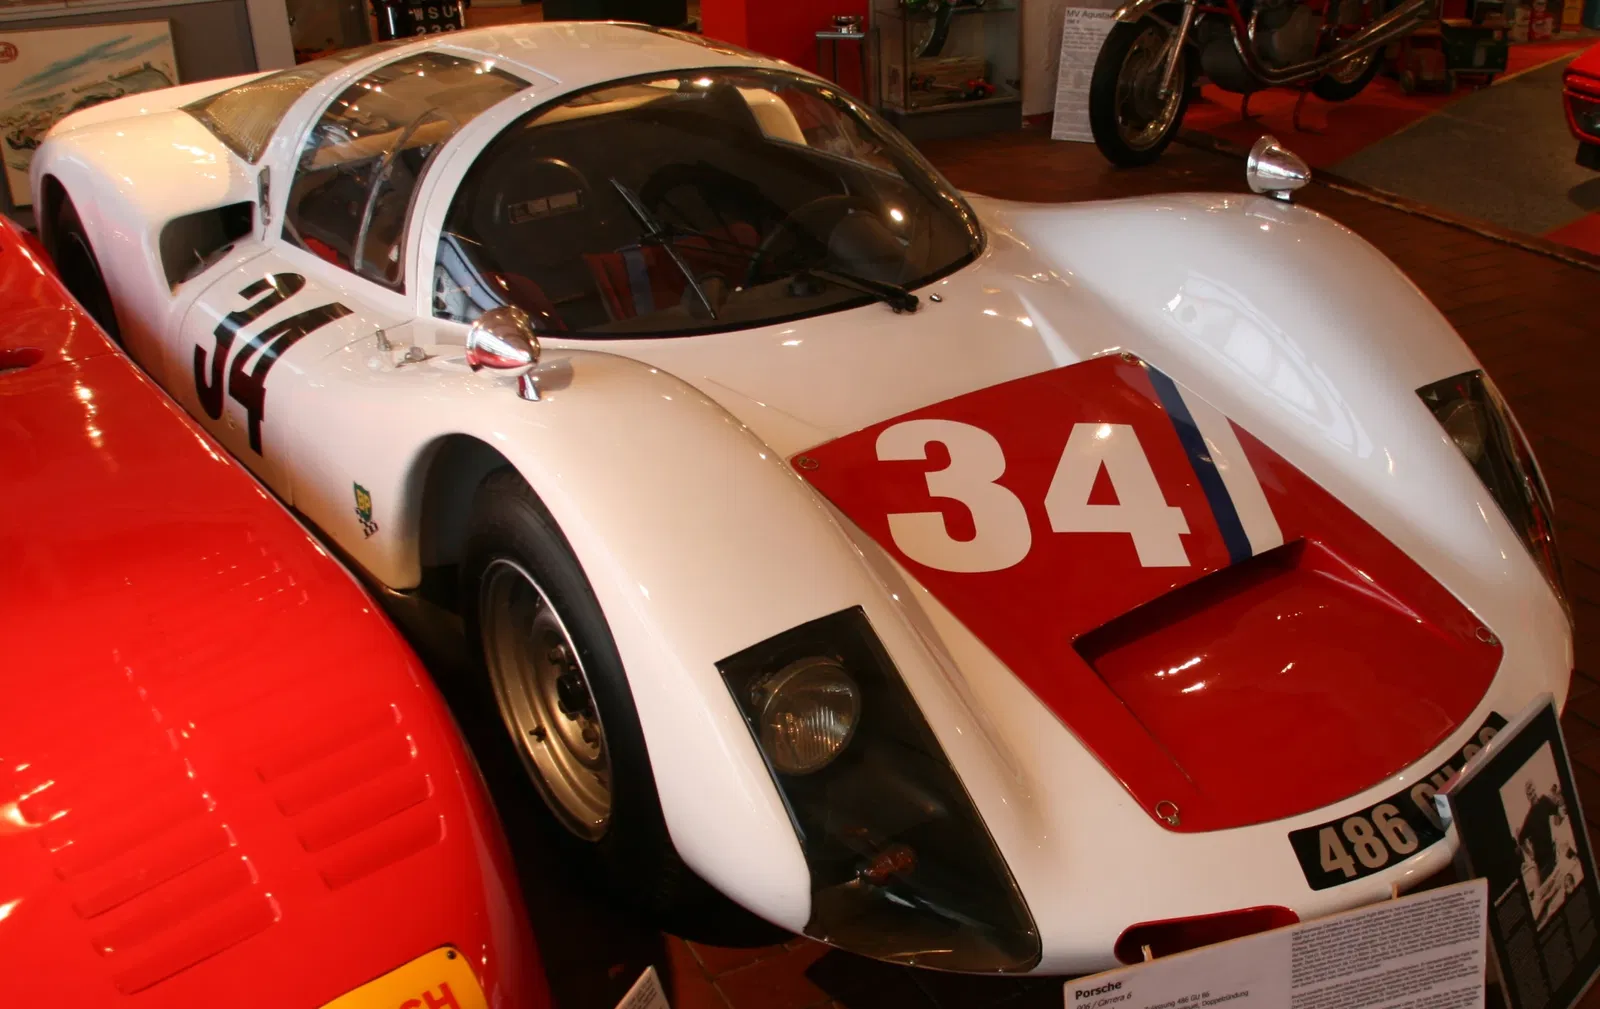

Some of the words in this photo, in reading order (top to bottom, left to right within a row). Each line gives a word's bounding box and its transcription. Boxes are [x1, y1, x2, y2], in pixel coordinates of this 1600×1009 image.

[194, 272, 355, 457] 34
[875, 418, 1192, 573] 34
[1319, 803, 1419, 878] 486
[1075, 981, 1122, 1000] Porsche
[1098, 995, 1125, 1008] Carrera
